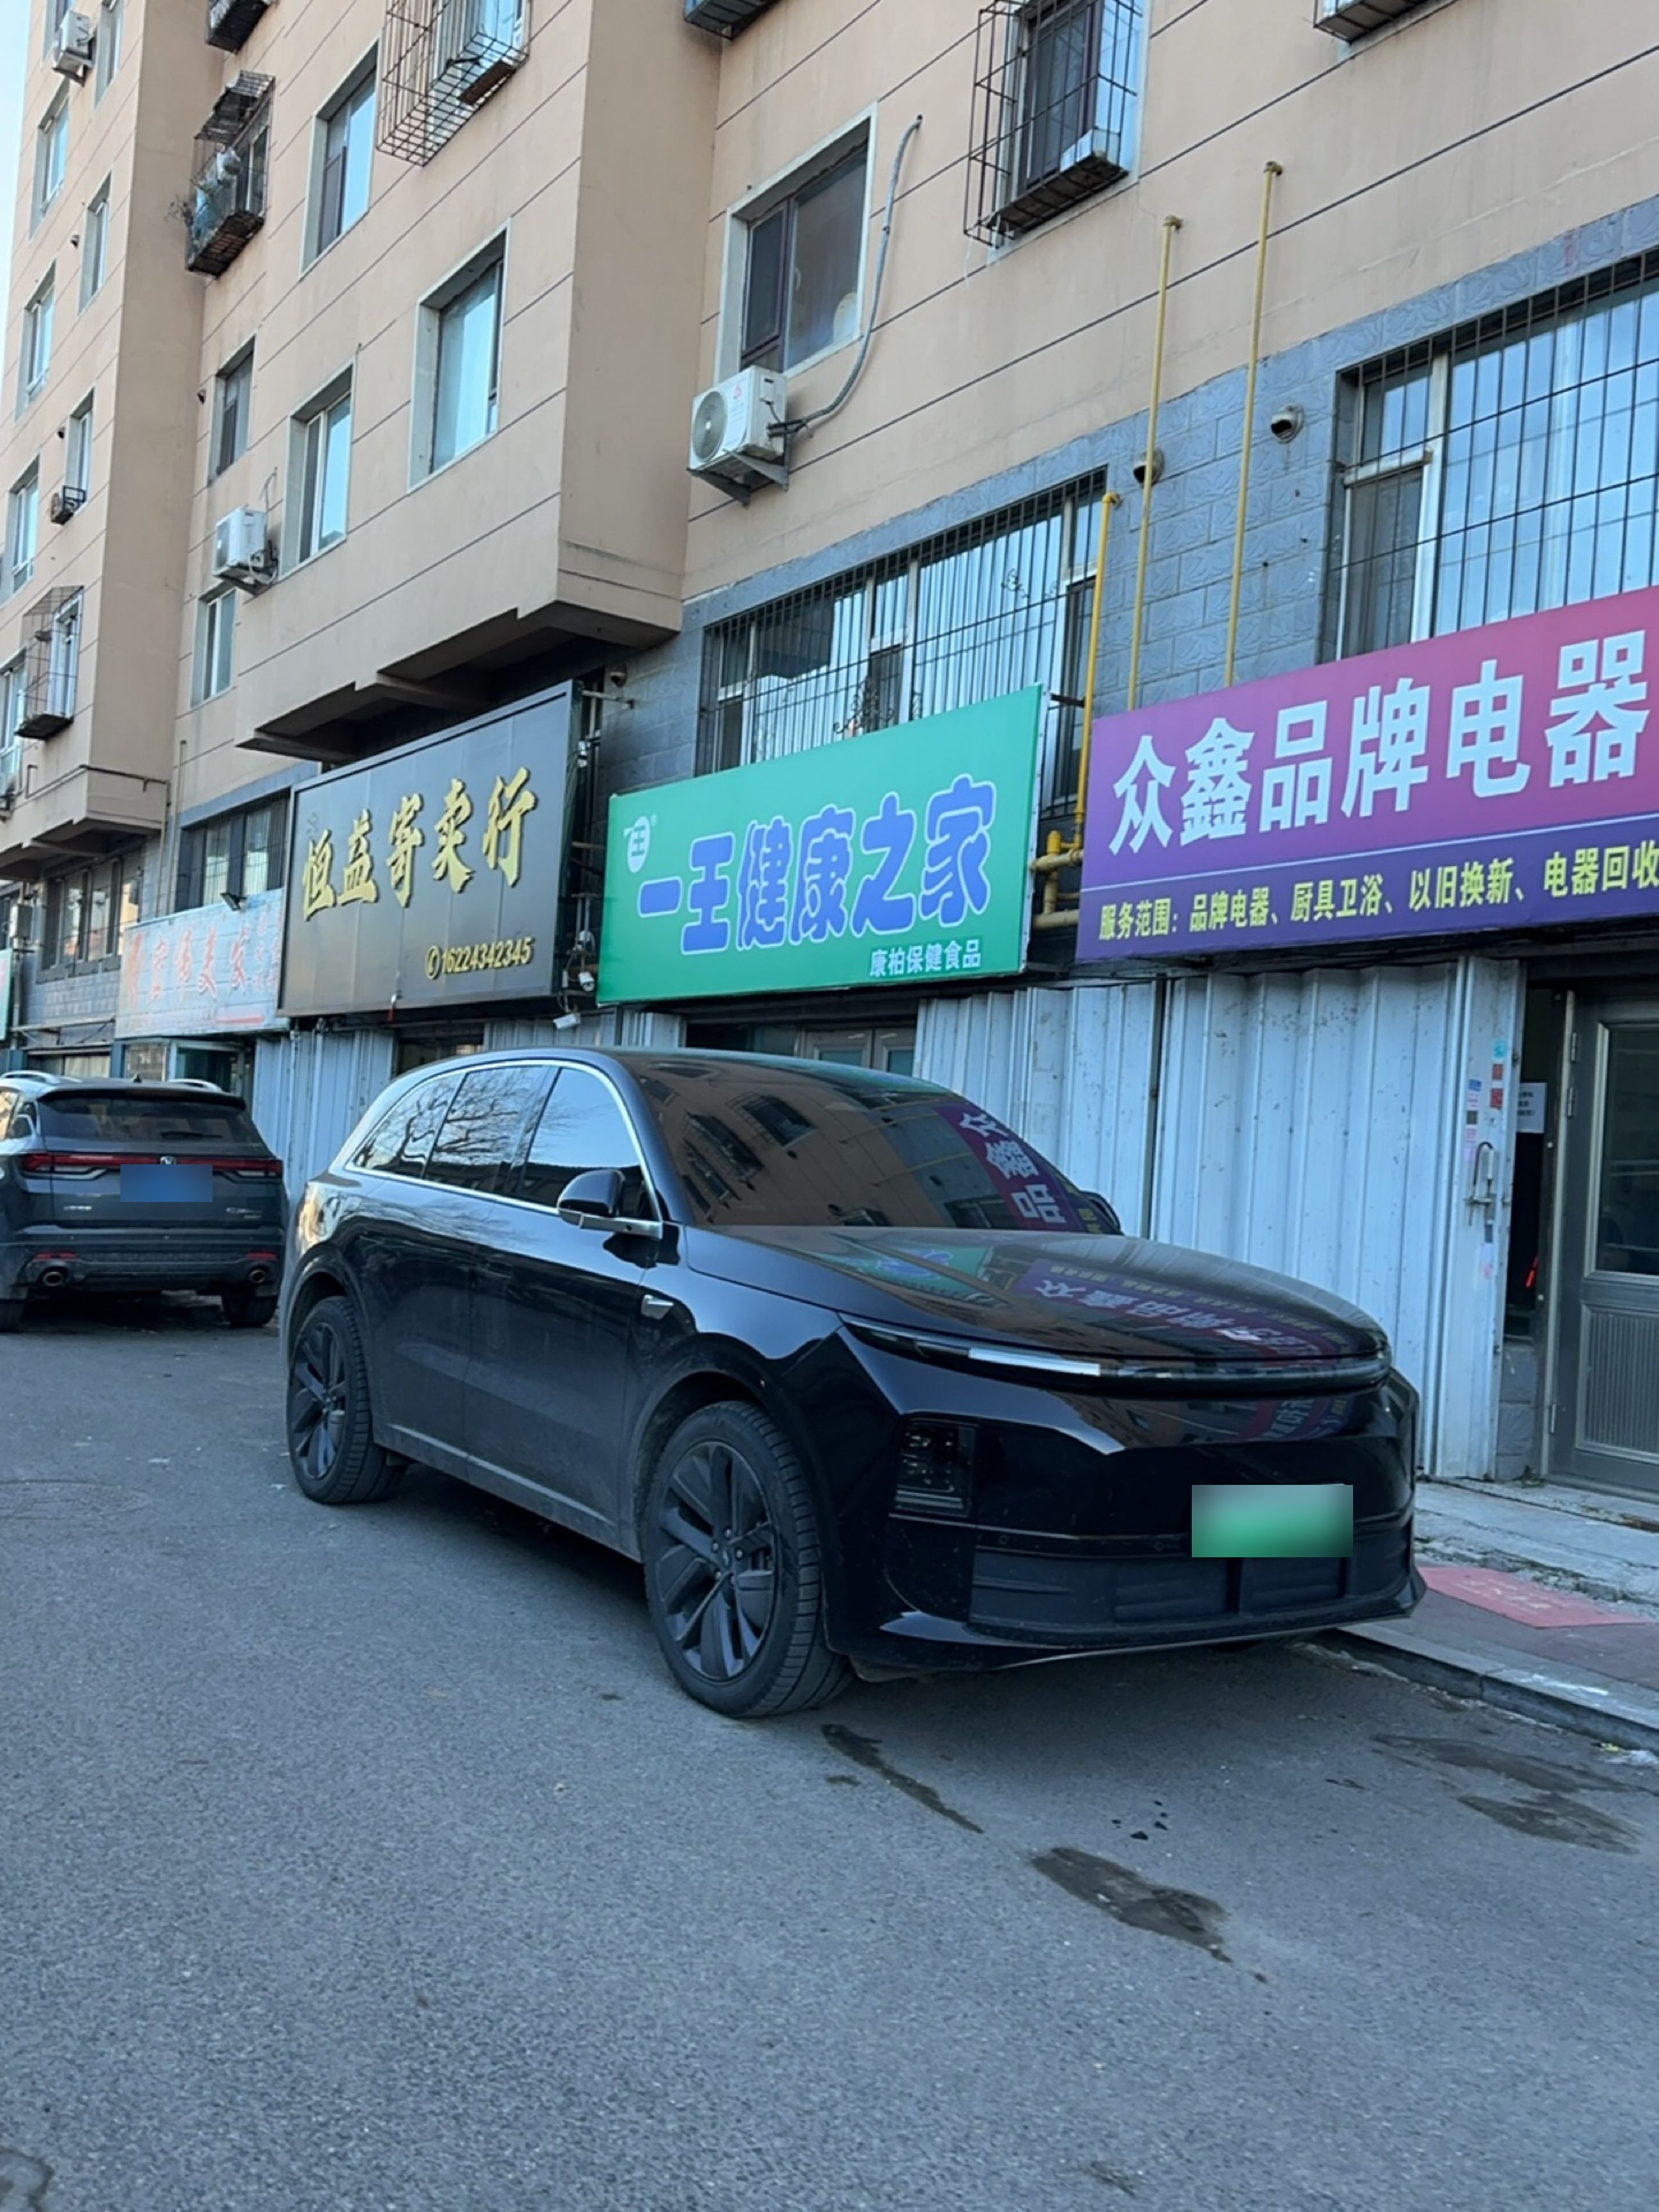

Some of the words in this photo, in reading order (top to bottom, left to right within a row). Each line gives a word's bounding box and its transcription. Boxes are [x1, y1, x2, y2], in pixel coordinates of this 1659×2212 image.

[1108, 630, 1650, 856] 众鑫品牌电器
[637, 773, 997, 954] 一王健康之家
[870, 939, 981, 977] 康柏保健食品
